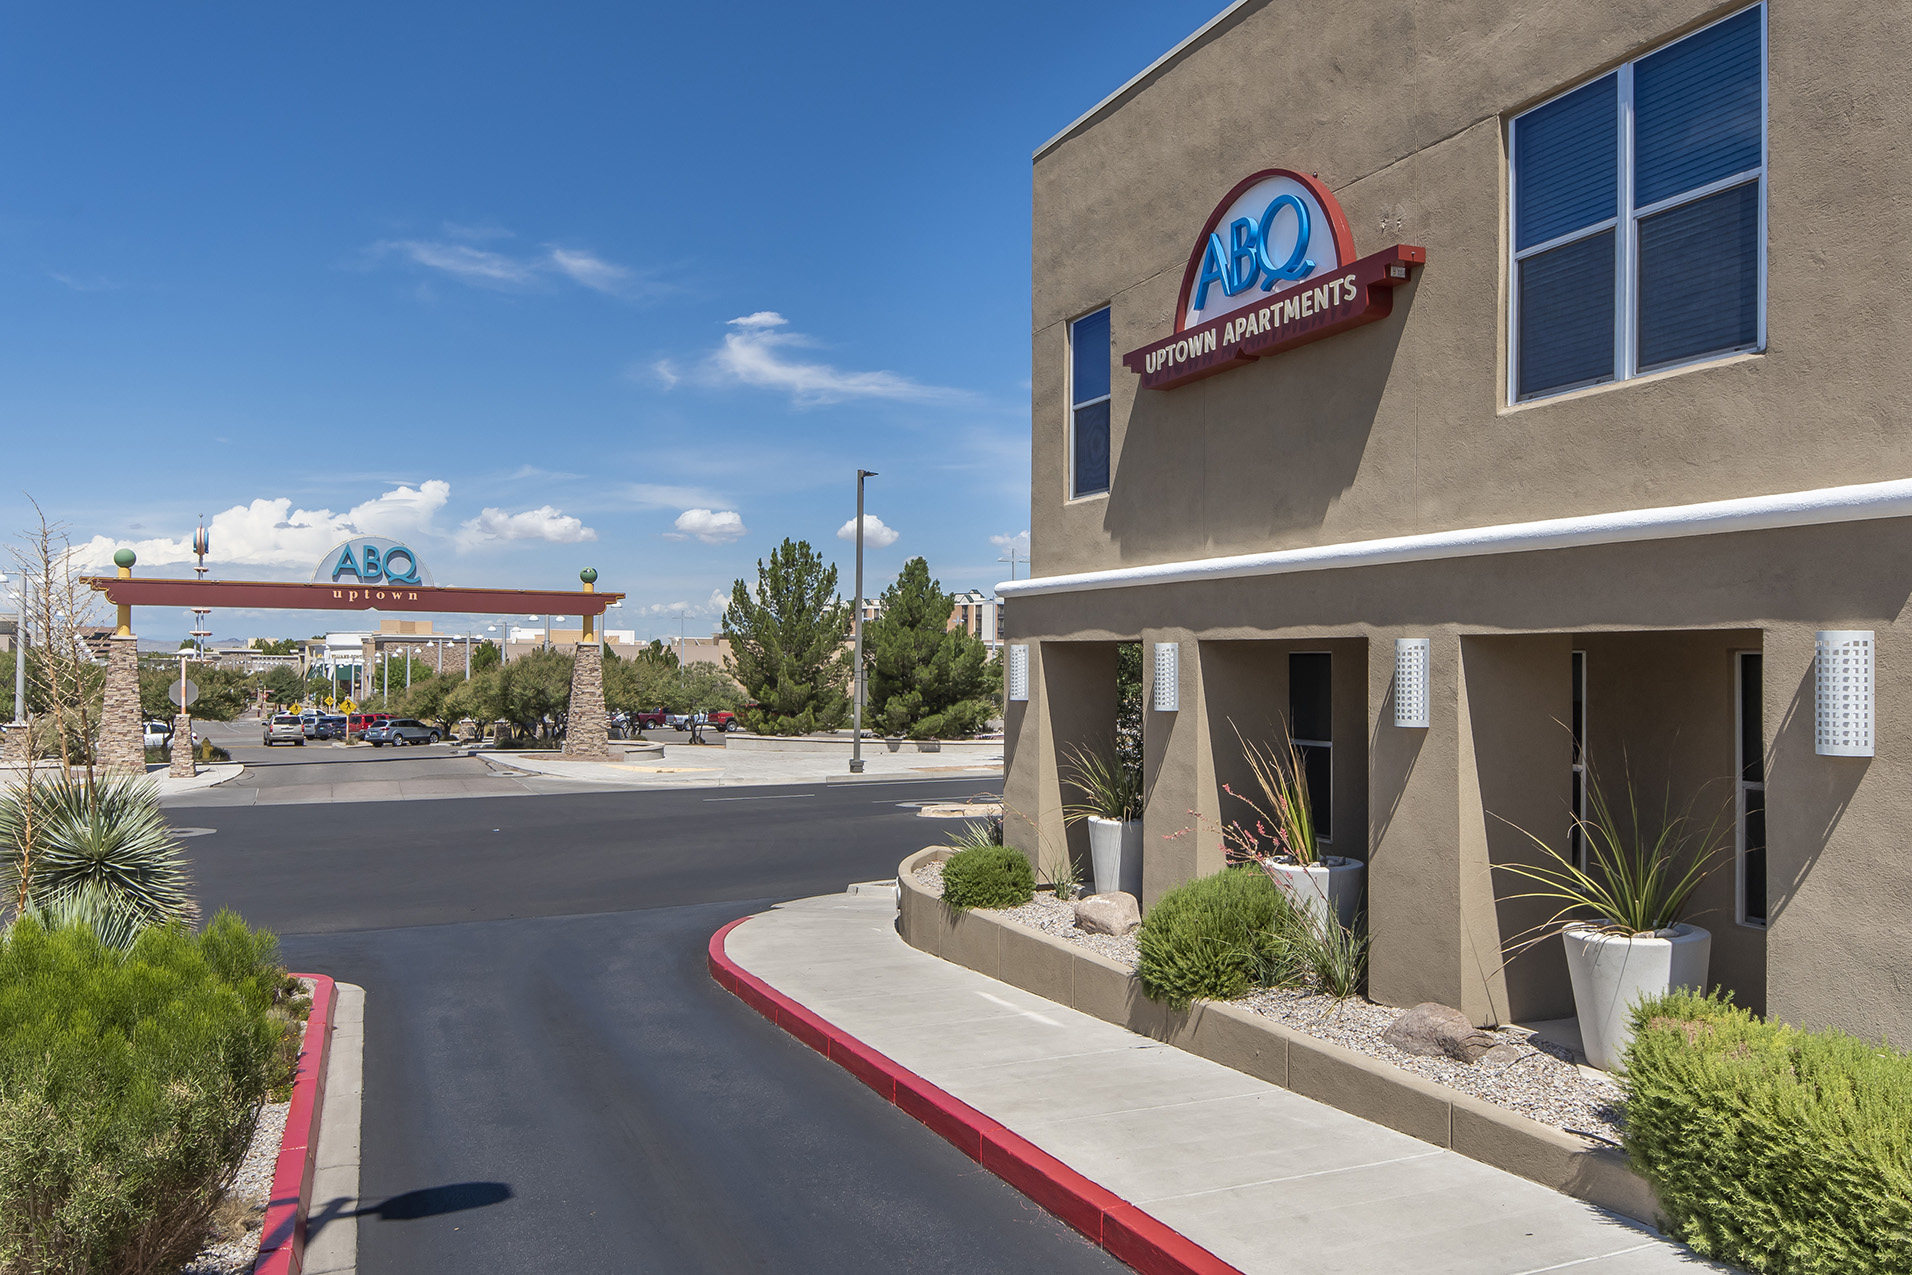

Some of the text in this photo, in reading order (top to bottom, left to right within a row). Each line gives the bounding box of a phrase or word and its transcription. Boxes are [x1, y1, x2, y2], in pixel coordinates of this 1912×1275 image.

[1193, 194, 1316, 311] ABQ
[1145, 274, 1357, 374] UPTOWN APARTMENTS
[332, 544, 421, 583] ABQ
[333, 589, 418, 602] uptown
